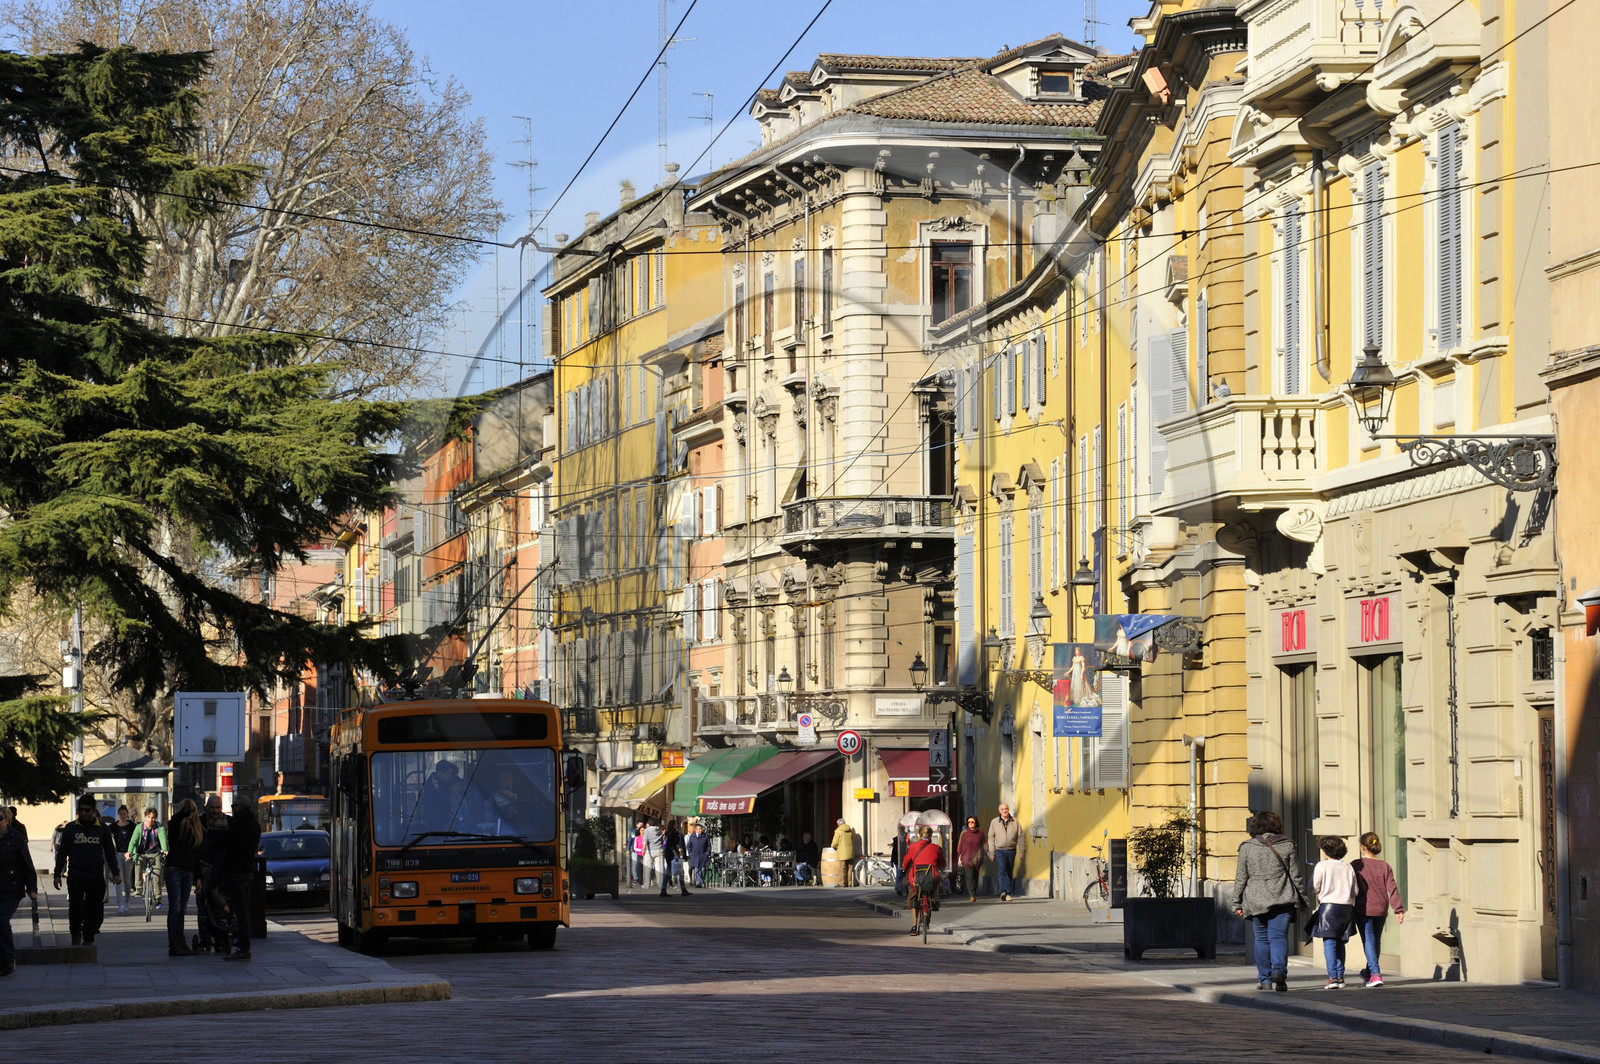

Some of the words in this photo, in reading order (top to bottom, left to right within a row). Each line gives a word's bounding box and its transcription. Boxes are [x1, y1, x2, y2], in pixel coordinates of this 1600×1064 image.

[426, 718, 435, 733] 1
[842, 737, 857, 749] 30
[637, 804, 660, 819] BAR
[467, 873, 479, 881] 039
